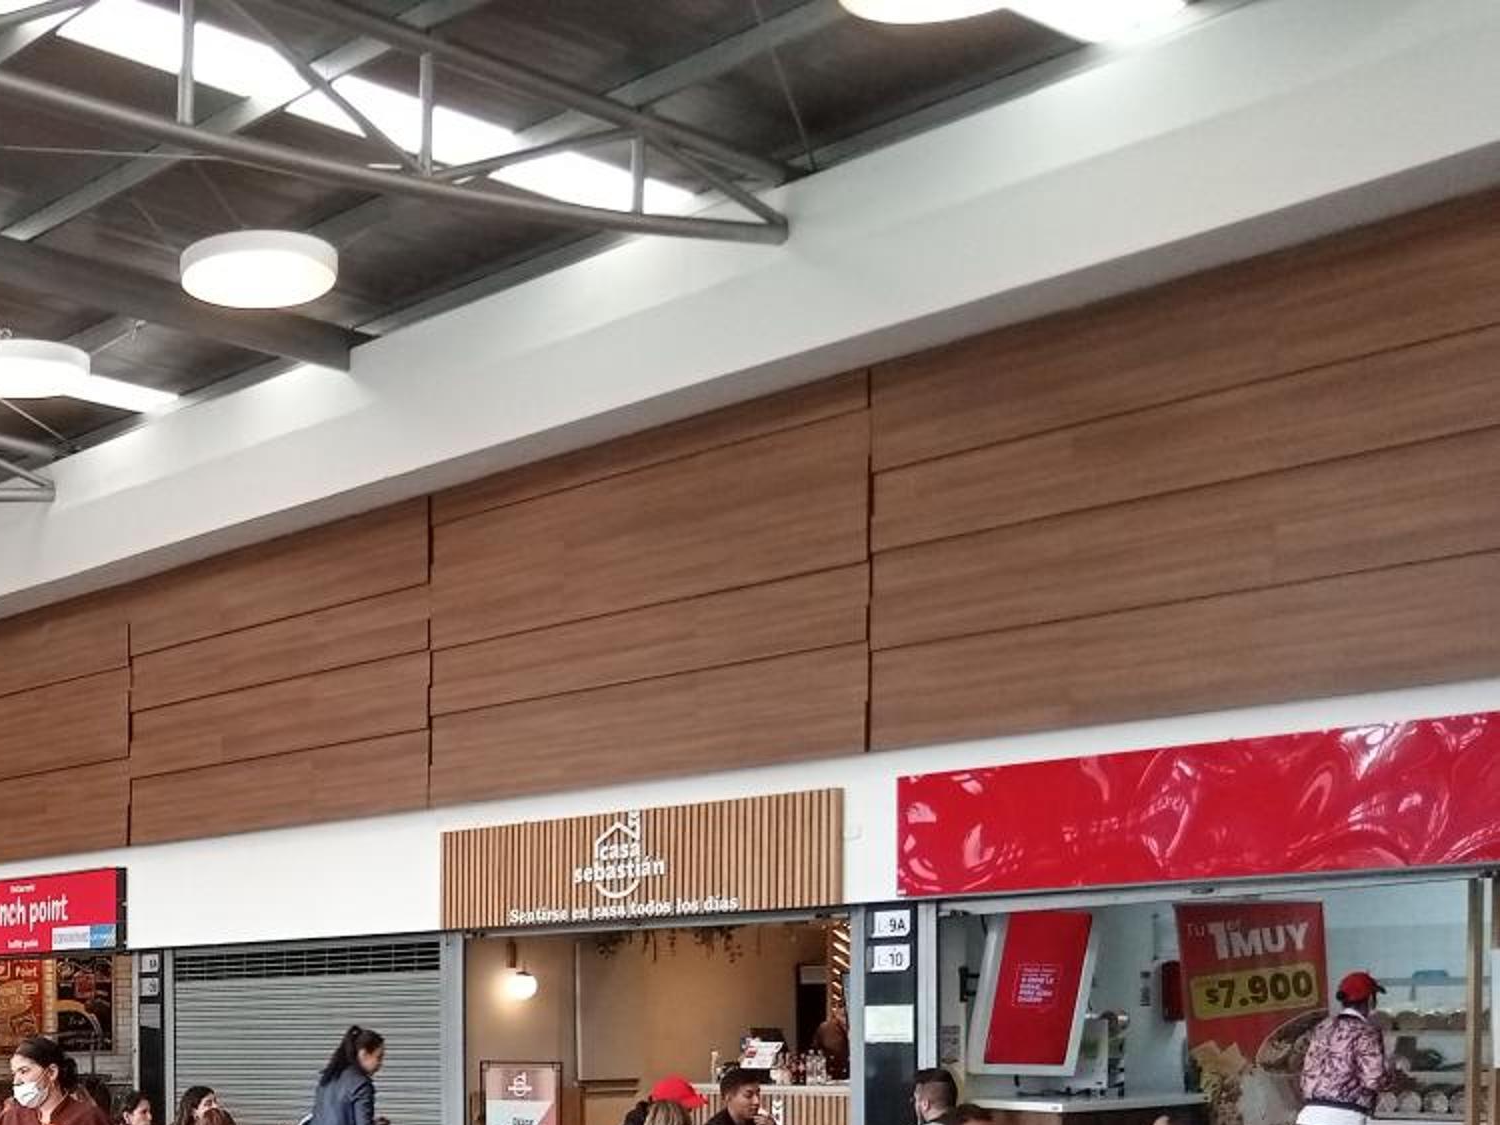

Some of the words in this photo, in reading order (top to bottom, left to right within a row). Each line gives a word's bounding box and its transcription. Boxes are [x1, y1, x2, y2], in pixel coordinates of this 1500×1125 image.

[600, 842, 641, 860] casa
[574, 855, 666, 883] sebastián
[29, 893, 68, 932] point
[509, 908, 567, 924] Sentirse
[572, 909, 589, 920] en
[593, 905, 626, 919] casa
[630, 900, 671, 917] todos
[677, 897, 699, 913] los
[704, 894, 739, 912] días
[1205, 971, 1313, 1008] $7.900
